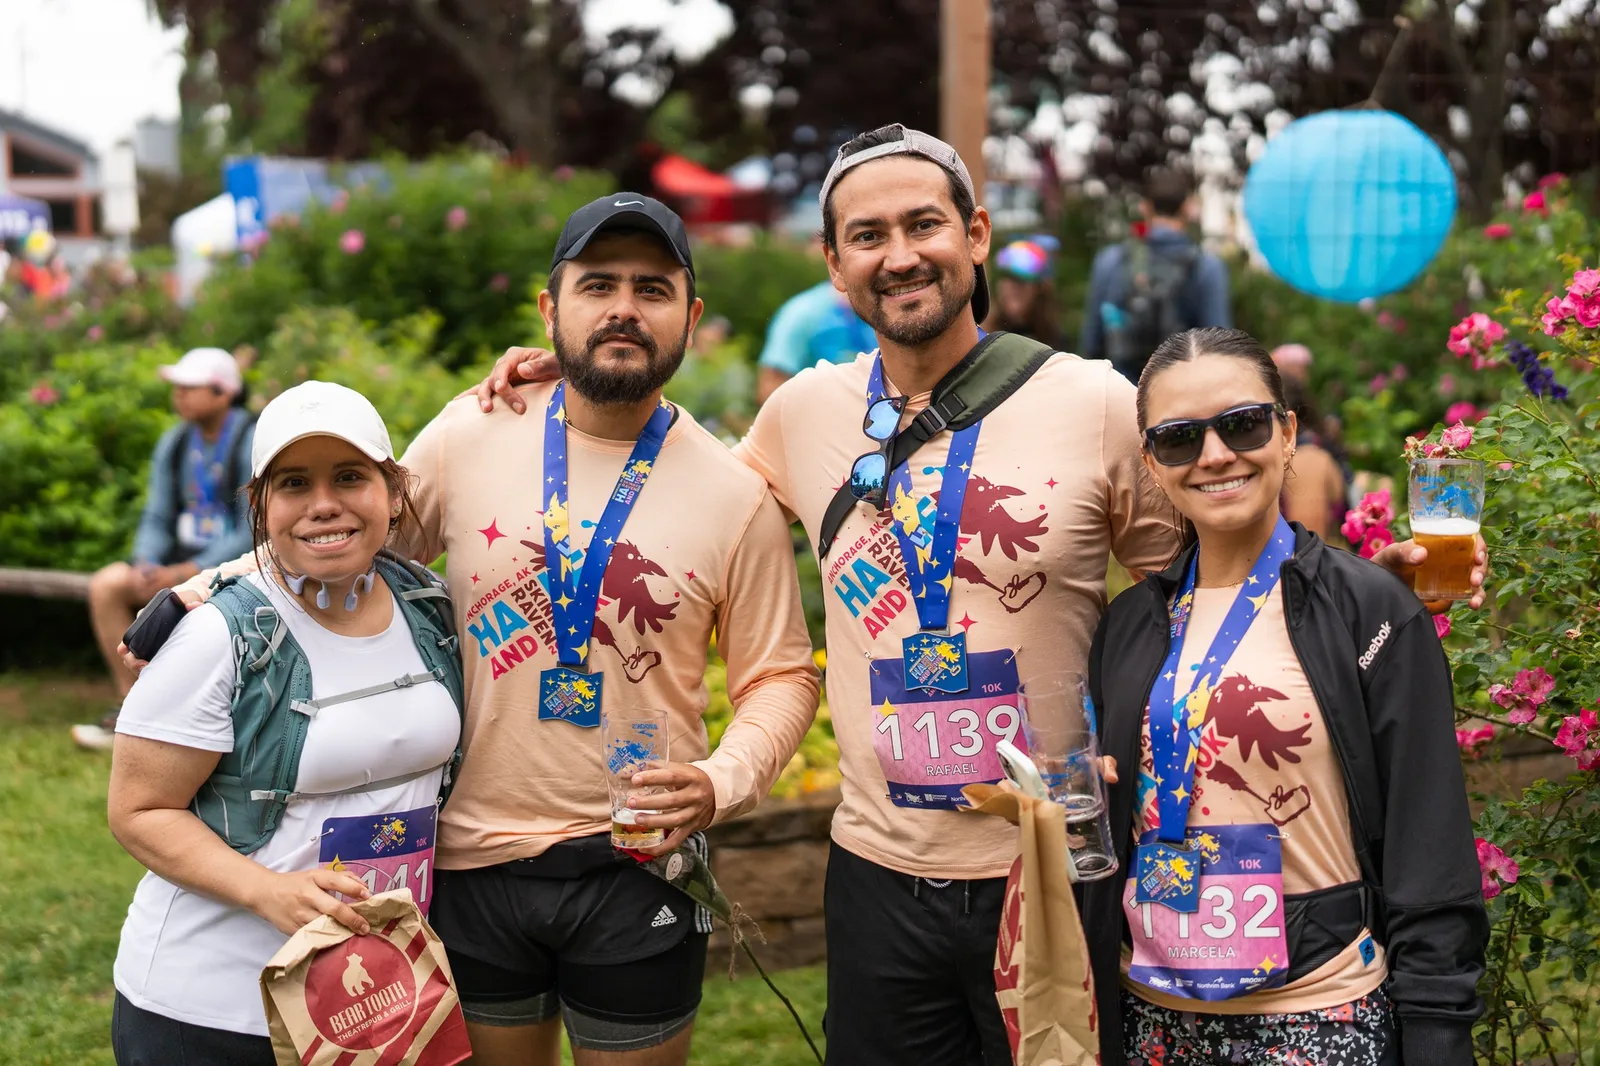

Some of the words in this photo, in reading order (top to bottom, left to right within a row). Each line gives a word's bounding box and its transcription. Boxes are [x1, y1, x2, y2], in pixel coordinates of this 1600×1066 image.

[827, 535, 872, 585] ANCHORAGE,
[870, 520, 884, 540] AK
[867, 541, 912, 592] RAVE
[878, 532, 904, 564] SKI
[466, 578, 517, 623] NCHORAGE,
[515, 566, 532, 582] AK
[523, 579, 554, 628] SKIN
[834, 557, 893, 619] HA
[467, 599, 530, 658] HA
[510, 586, 557, 647] RAVEN
[862, 589, 907, 640] AND
[490, 635, 539, 681] AND
[1358, 620, 1392, 671] Reebok
[981, 682, 1003, 694] 10K
[876, 704, 1021, 761] 1139
[926, 763, 979, 776] RAFAEL
[1238, 859, 1262, 870] 10K
[651, 915, 678, 928] adidas
[1167, 946, 1237, 959] MARCELA
[328, 1002, 368, 1035] BEAR
[362, 980, 408, 1016] TOOTH
[336, 1014, 384, 1042] THEATREPUB
[383, 1010, 390, 1019] &
[389, 999, 413, 1015] GRILL
